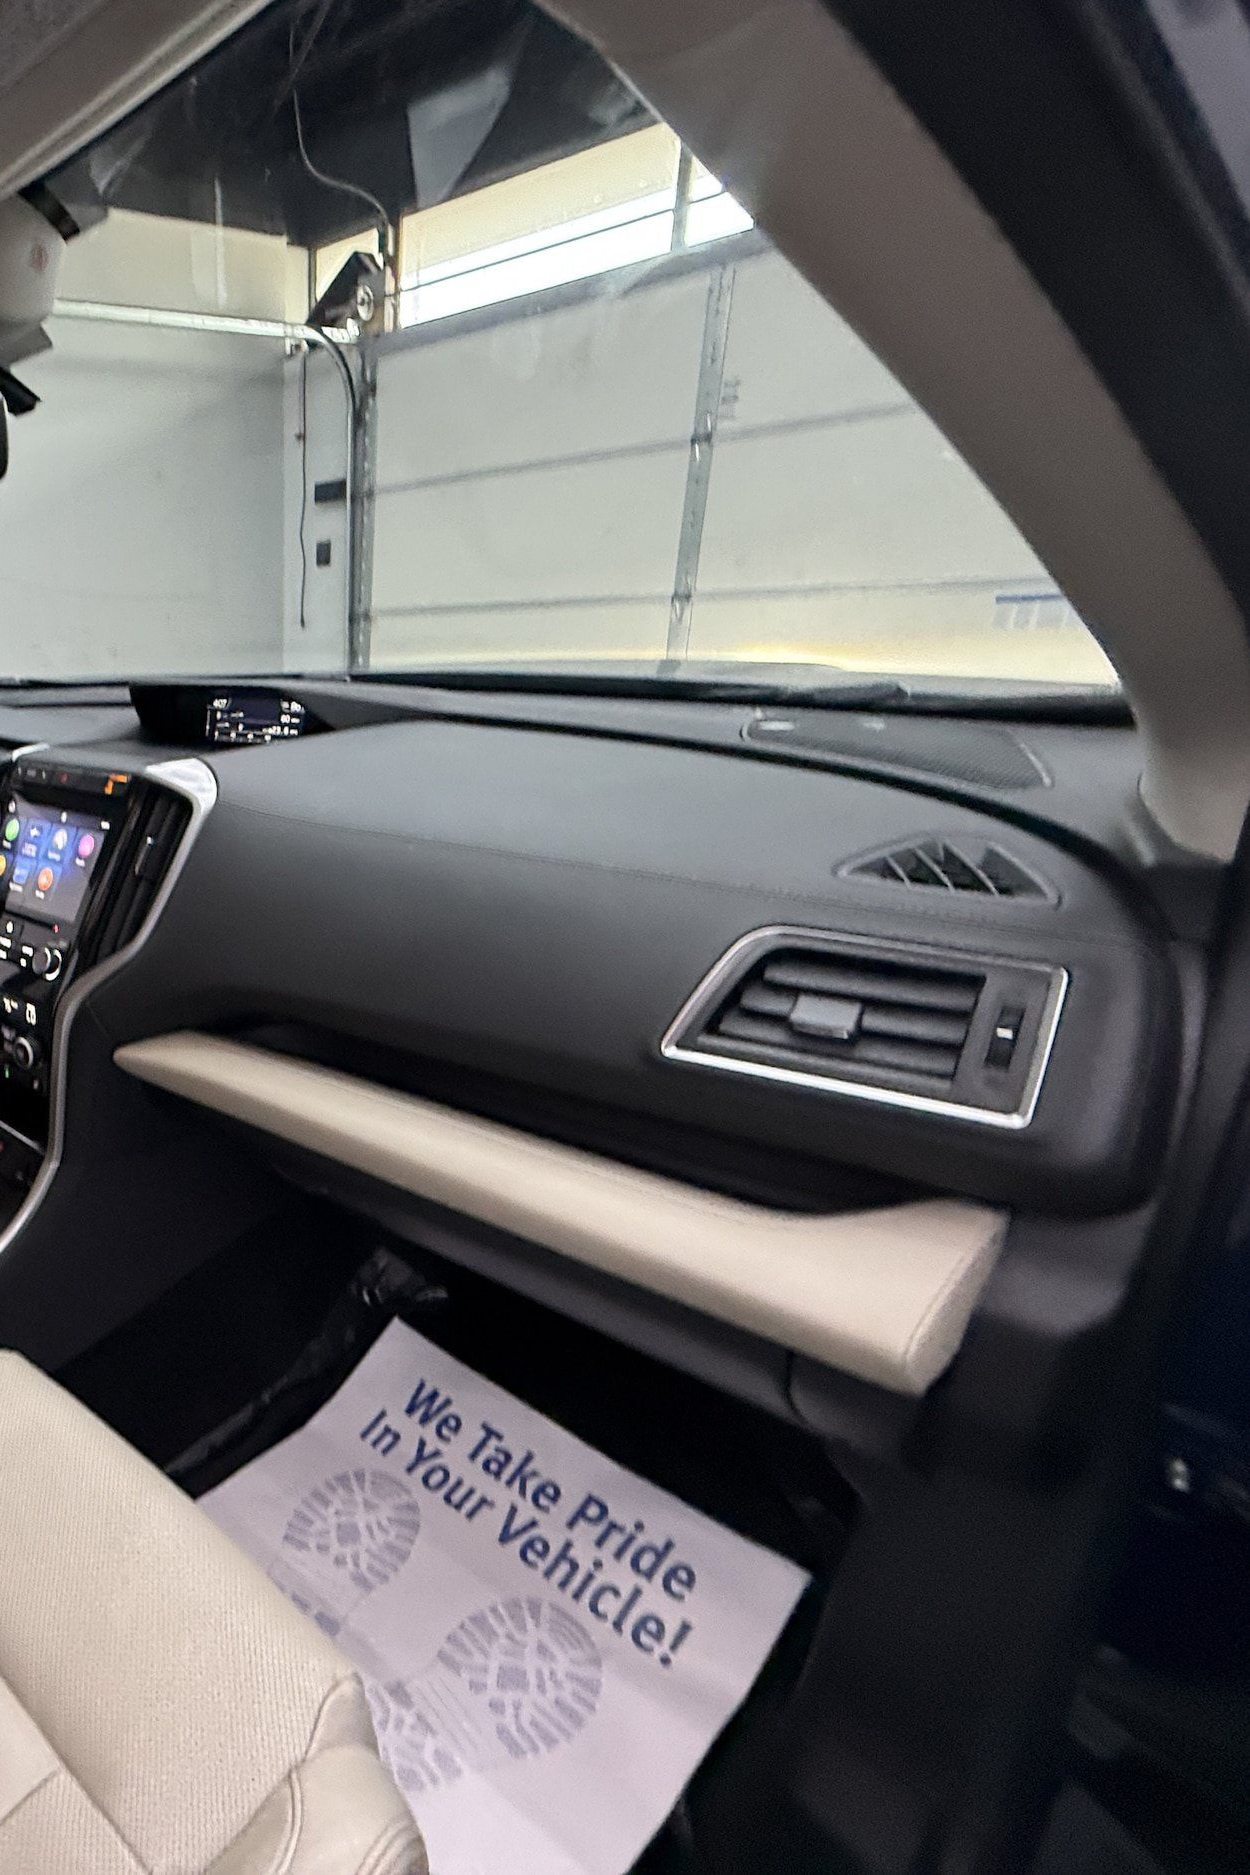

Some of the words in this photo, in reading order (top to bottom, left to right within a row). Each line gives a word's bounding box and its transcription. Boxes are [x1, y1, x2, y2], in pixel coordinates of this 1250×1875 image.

[359, 1408, 402, 1457] In
[404, 1436, 495, 1522] Your
[496, 1502, 693, 1667] Vehicle!
[403, 1378, 463, 1443] We
[466, 1421, 562, 1515] Take
[565, 1492, 696, 1602] Pride
